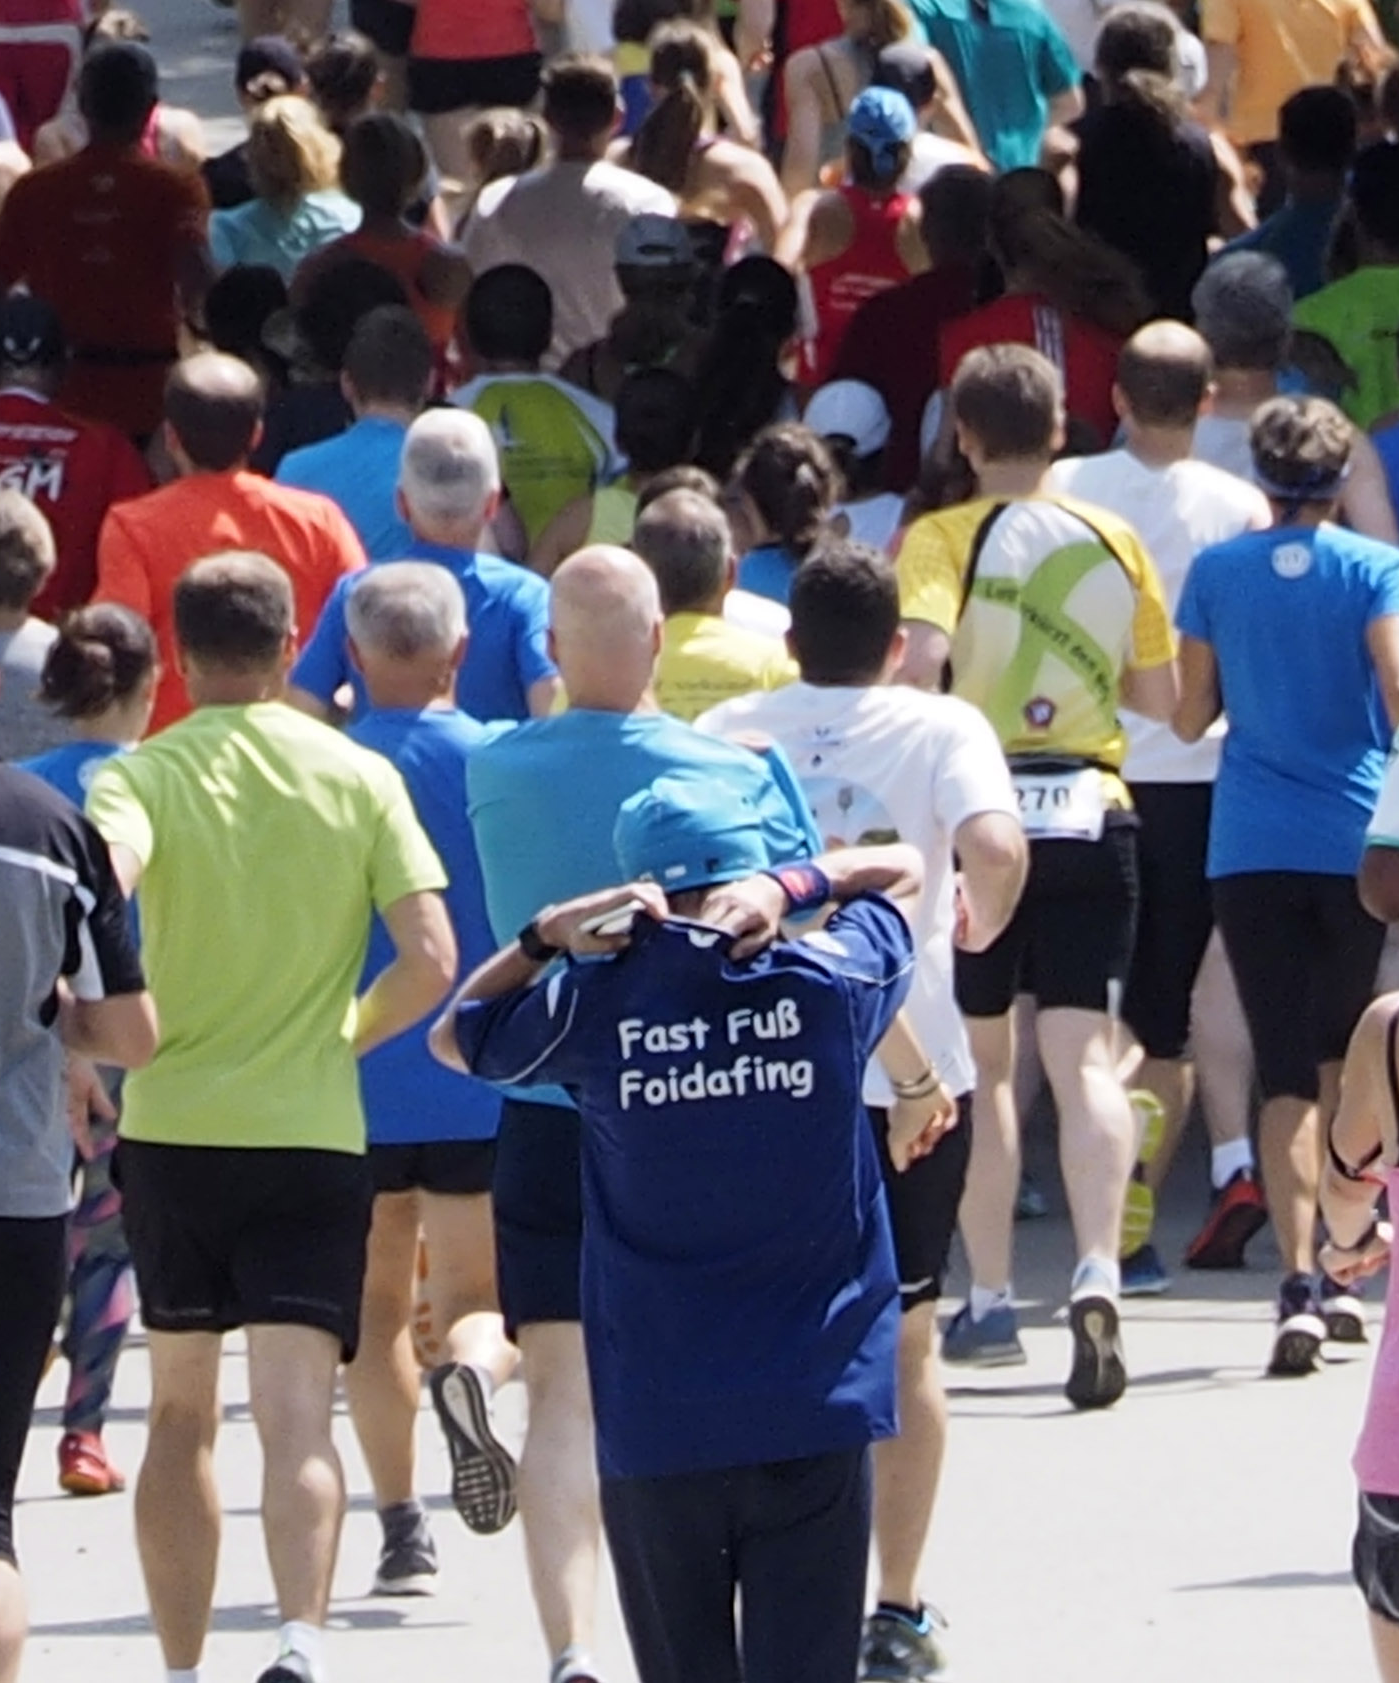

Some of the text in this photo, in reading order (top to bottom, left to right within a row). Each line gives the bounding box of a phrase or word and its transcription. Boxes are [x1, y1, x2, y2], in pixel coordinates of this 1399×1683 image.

[618, 998, 801, 1060] Fast Fuß
[619, 1055, 814, 1110] Foidafing
